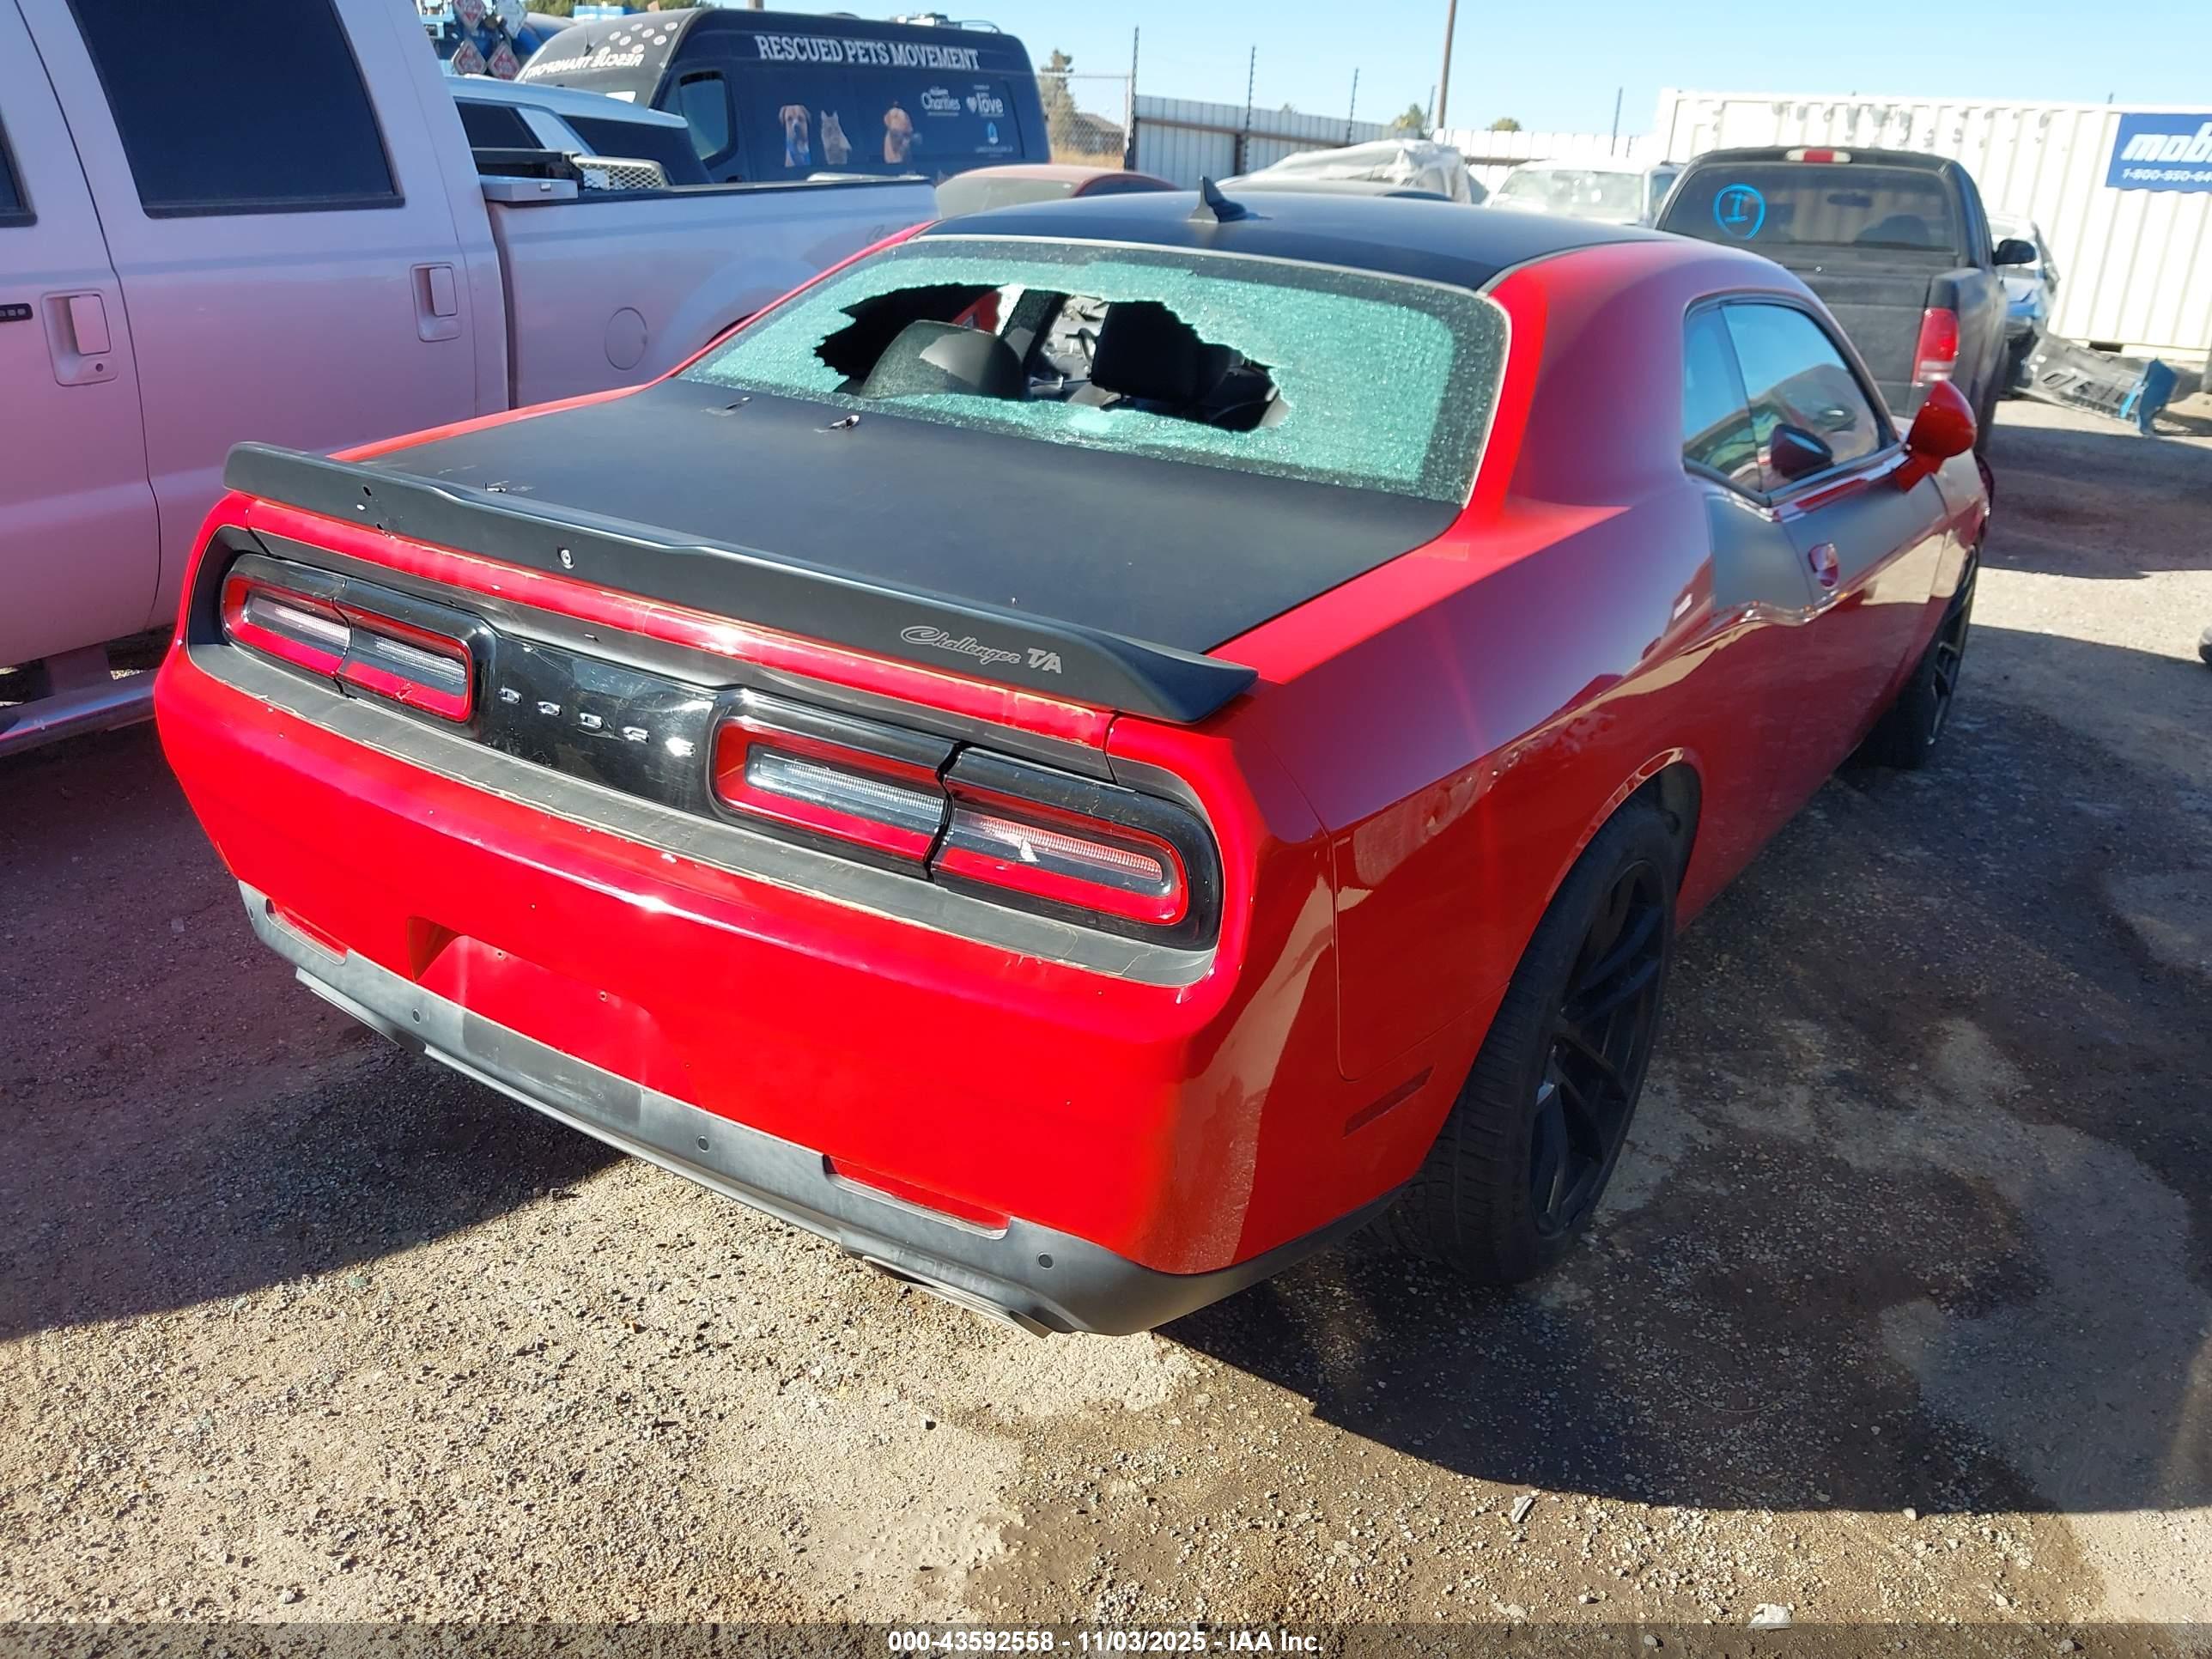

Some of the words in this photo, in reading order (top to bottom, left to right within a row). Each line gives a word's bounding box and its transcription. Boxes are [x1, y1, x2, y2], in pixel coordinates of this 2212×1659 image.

[754, 34, 844, 62] RESCUED
[844, 40, 890, 65] PETS
[890, 44, 981, 70] MOVEMENT
[920, 92, 962, 111] Charities
[975, 92, 1004, 113] love
[900, 625, 1022, 665] Challenger
[1026, 647, 1063, 674] T/A
